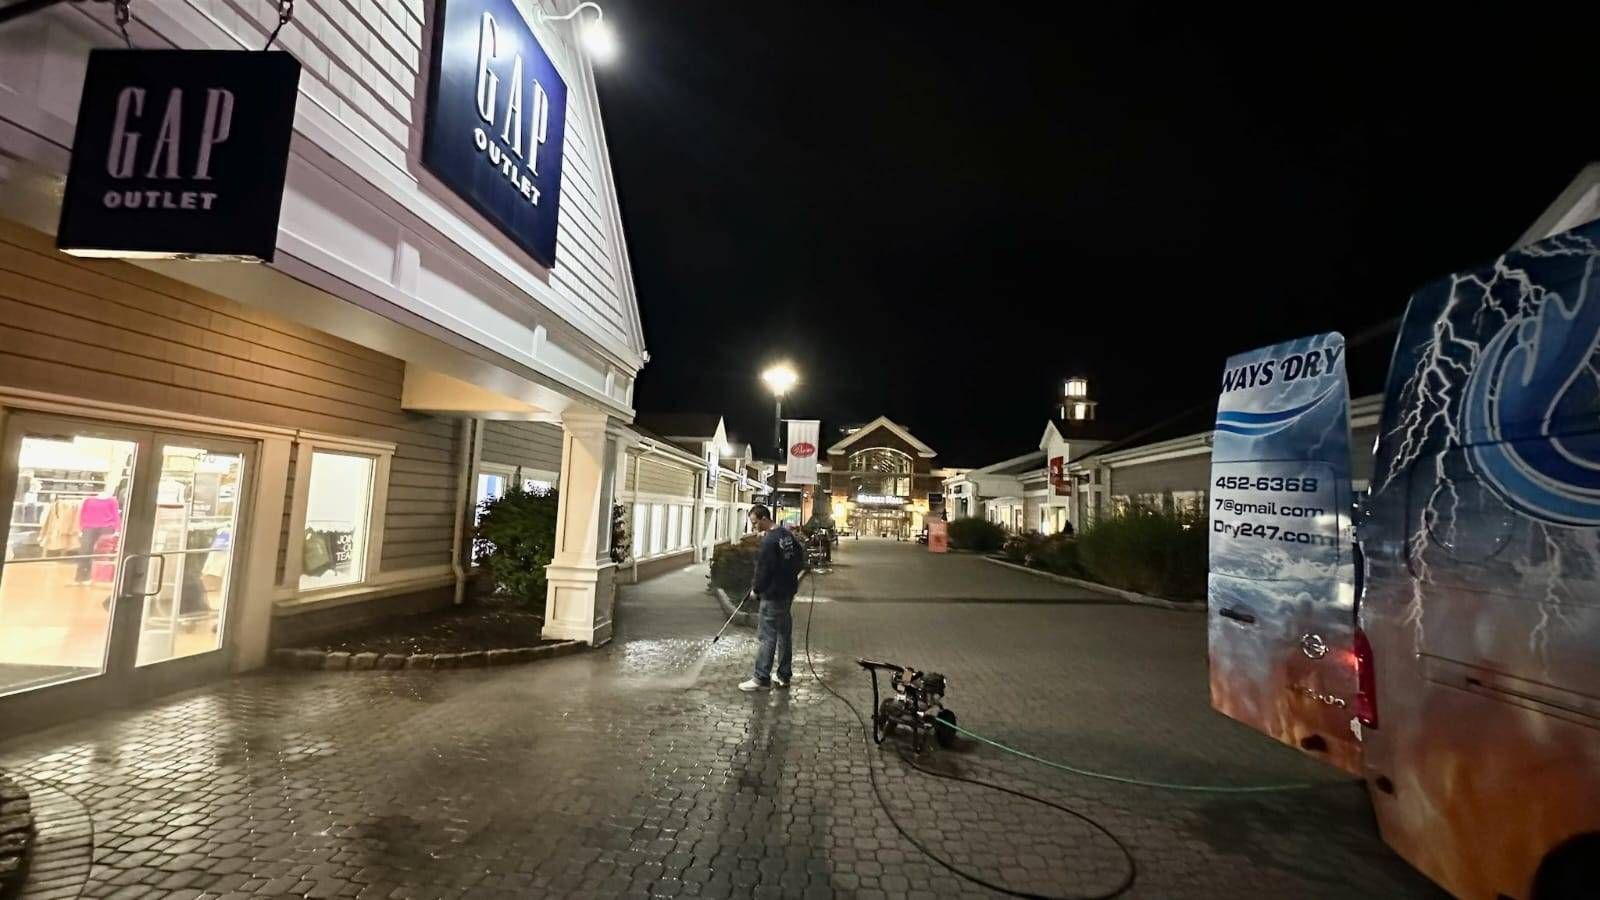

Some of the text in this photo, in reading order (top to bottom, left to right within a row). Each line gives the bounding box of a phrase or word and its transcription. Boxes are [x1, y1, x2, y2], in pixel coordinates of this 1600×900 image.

[476, 11, 549, 177] GAP
[107, 86, 235, 180] GAP
[473, 127, 541, 207] OUTLET
[103, 190, 218, 210] OUTLET
[1280, 345, 1344, 382] DRY
[1215, 476, 1318, 493] 452-6368
[1213, 519, 1336, 547] Dry247.com
